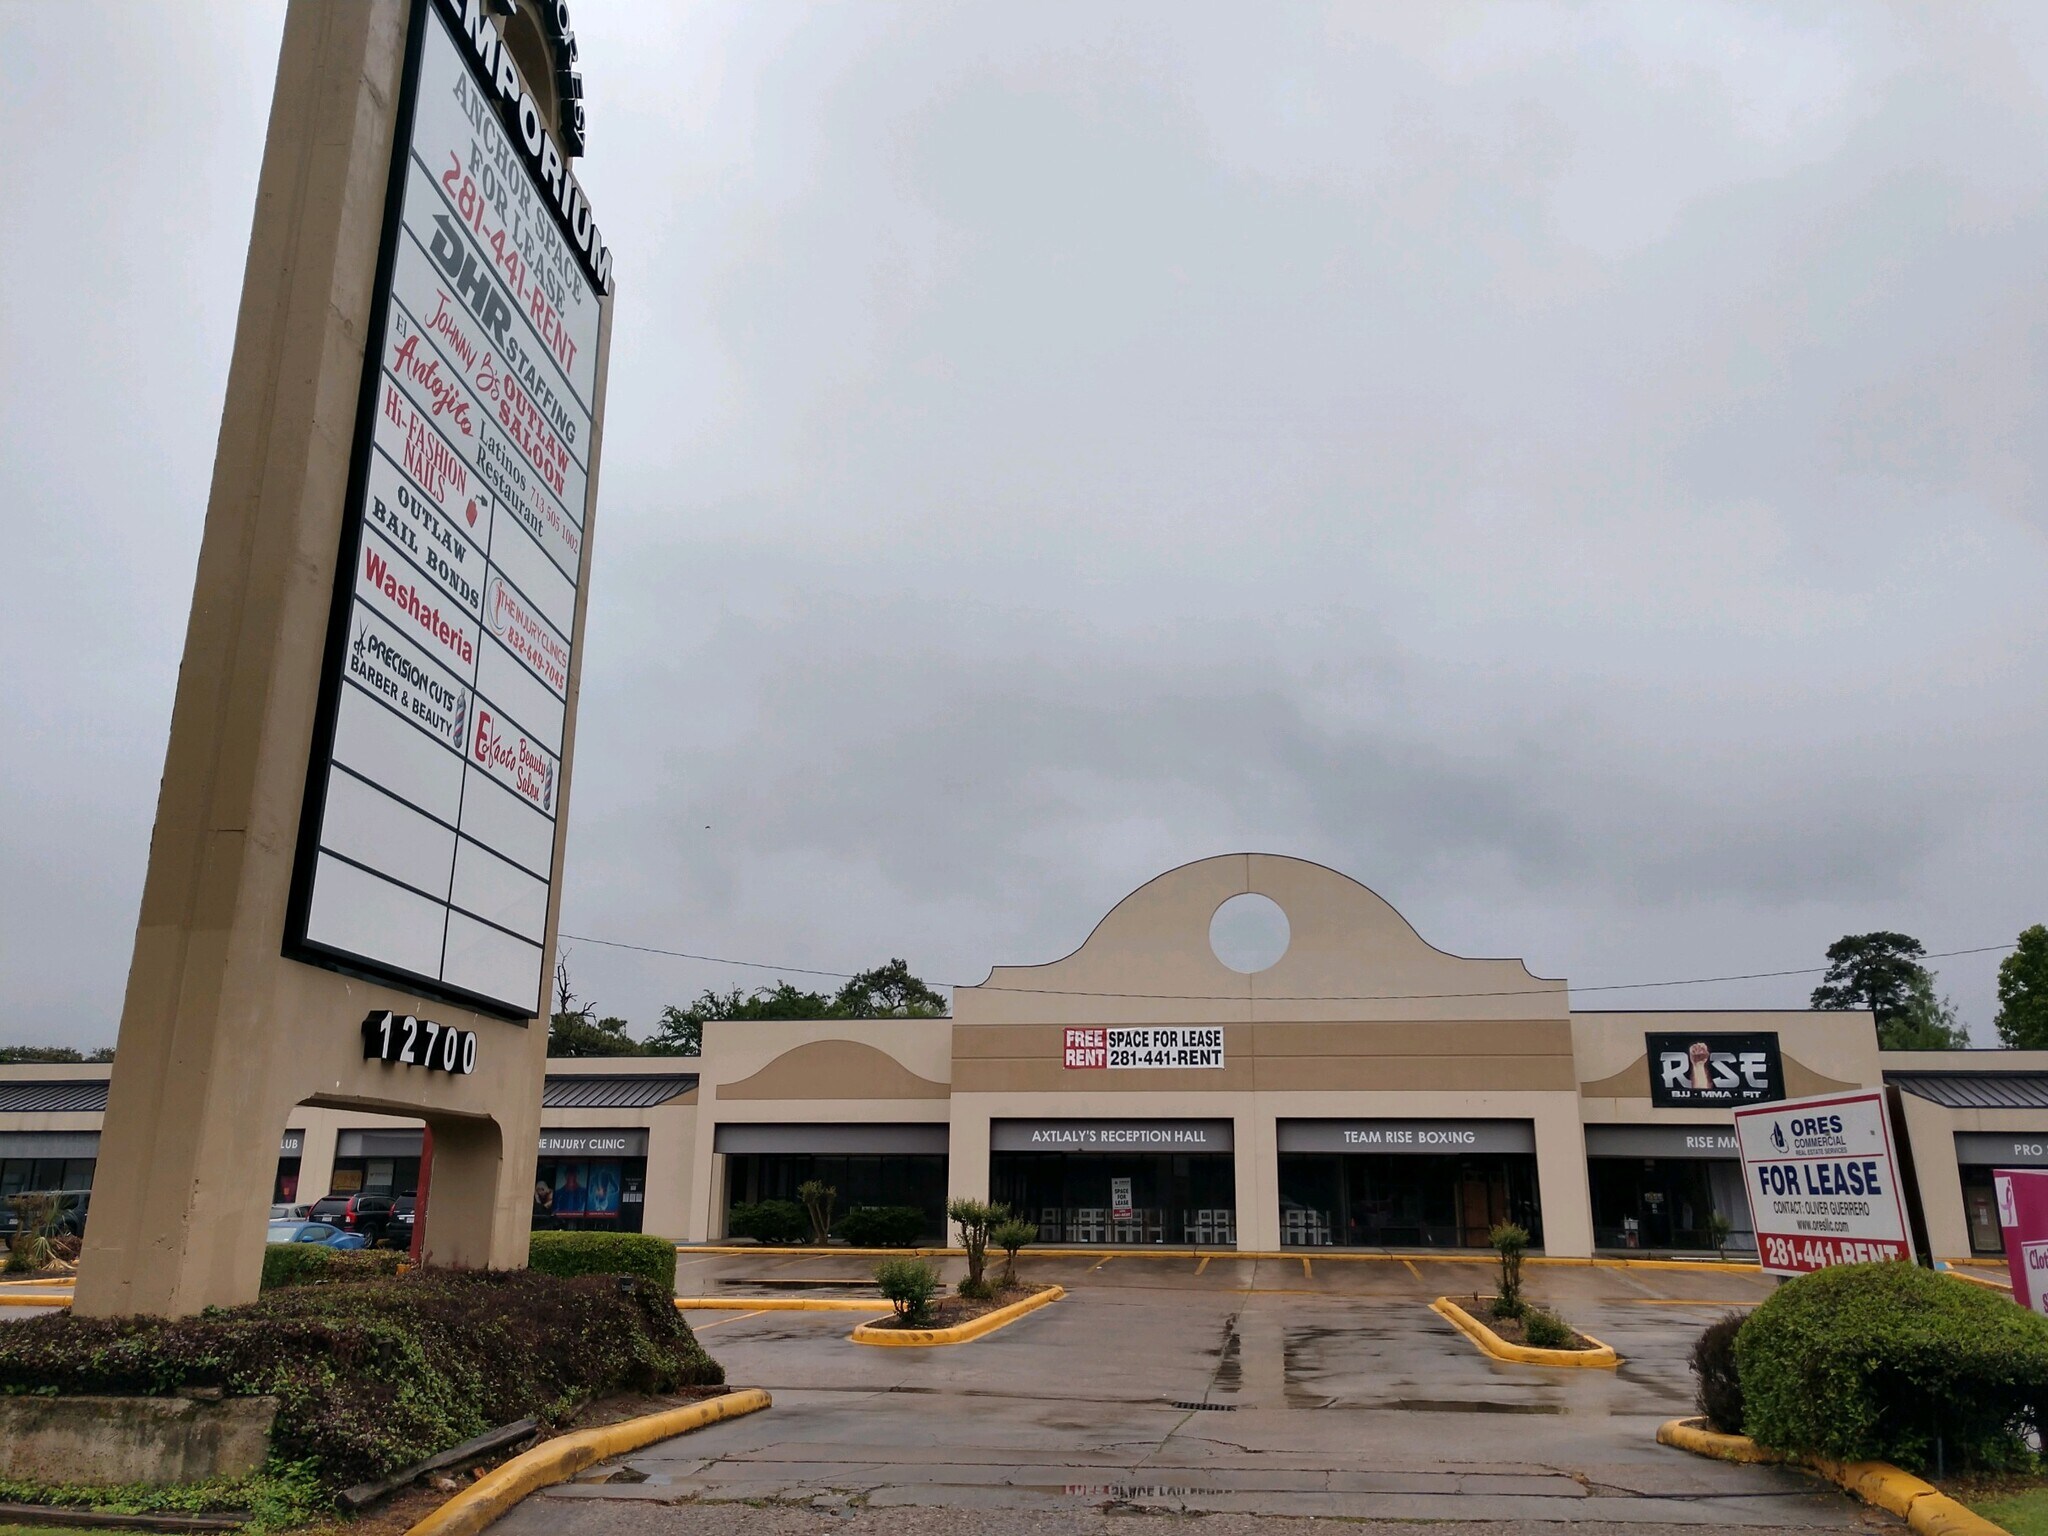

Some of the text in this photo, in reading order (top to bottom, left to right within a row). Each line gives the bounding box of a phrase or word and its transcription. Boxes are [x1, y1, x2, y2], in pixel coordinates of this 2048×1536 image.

[452, 71, 582, 305] ANCHOR SPACE
[468, 138, 566, 319] FOR LEASE
[442, 150, 578, 376] 281-441-RENT
[395, 313, 407, 338] El
[429, 214, 576, 444] DHR STAFFING
[393, 335, 474, 437] Antojito
[503, 374, 569, 474] OUTLAW
[403, 438, 446, 504] NAILS
[499, 400, 565, 497] SALOON
[476, 443, 543, 538] Restaurant
[480, 418, 578, 554] Latinos 713 505 1002
[398, 485, 467, 563] OUTLAW
[372, 496, 479, 609] BAIL BONDS
[365, 547, 472, 665] Washateria
[515, 606, 542, 643] INJURY
[351, 654, 452, 737] BARBER & BEAUTY
[368, 634, 455, 712] PRECISION CUTS
[519, 738, 546, 783] Beauty
[516, 766, 539, 801] Salon
[379, 1011, 478, 1075] 12700
[1065, 1049, 1222, 1066] RENT 281-441-RENT
[1066, 1030, 1221, 1047] FREE SPACE FOR LEASE
[1671, 1090, 1761, 1098] BJJ MMA FIT
[549, 1138, 587, 1150] INJURY
[588, 1138, 626, 1150] CLINIC
[1031, 1130, 1206, 1143] AXTLALY'S RECEPTION HALL
[1344, 1131, 1476, 1144] TEAM RISE BOXING
[1686, 1136, 1714, 1148] RISE
[1790, 1115, 1843, 1137] ORES
[1794, 1136, 1847, 1149] COMMERCIAL
[2014, 1144, 2043, 1156] PRO
[1758, 1161, 1882, 1196] FOR LEASE
[1773, 1201, 1870, 1217] CONTACT: OLIVER GUERRERO
[1796, 1217, 1850, 1233] www.oresllc.com
